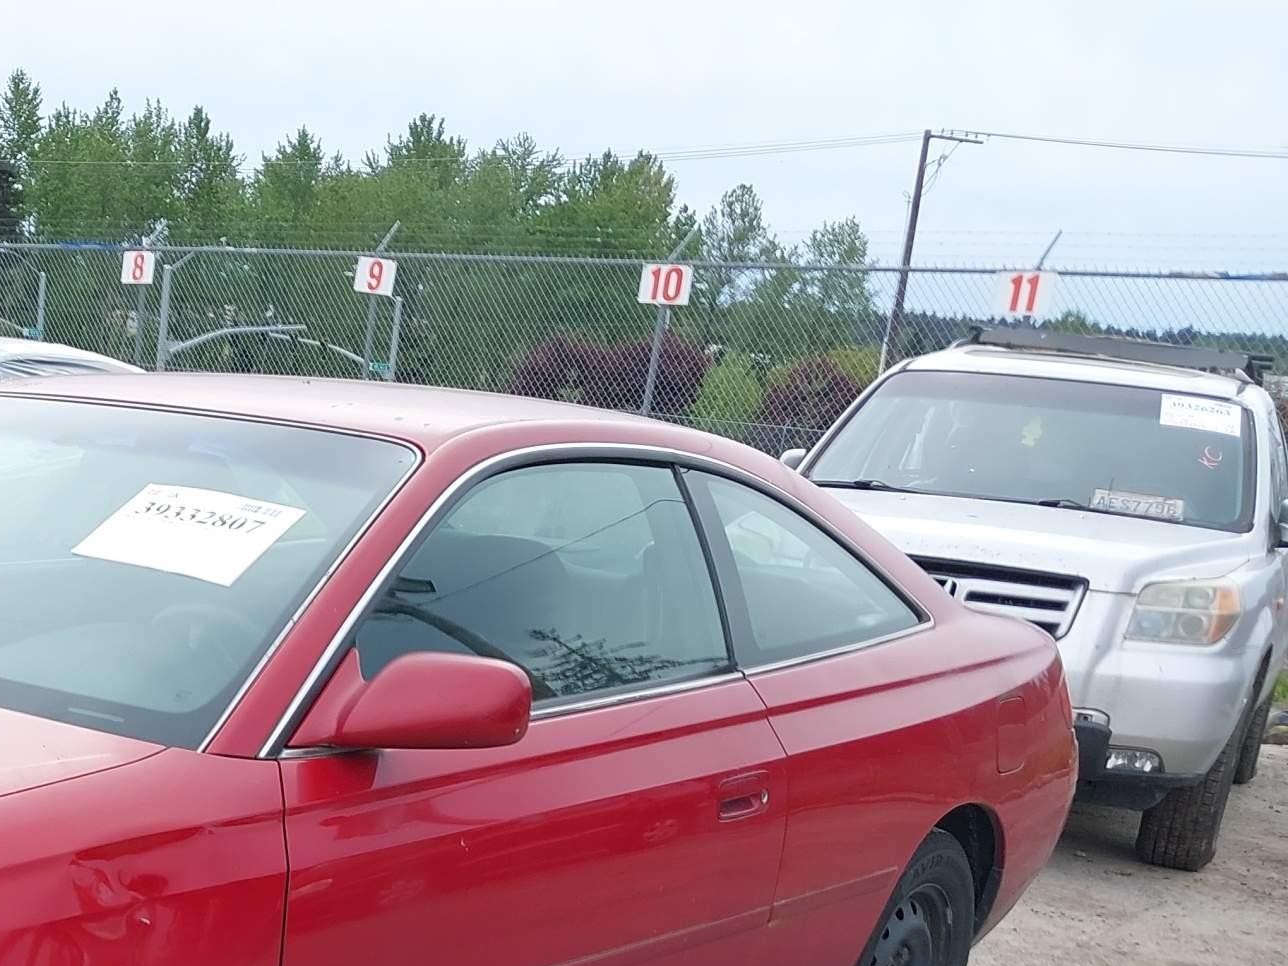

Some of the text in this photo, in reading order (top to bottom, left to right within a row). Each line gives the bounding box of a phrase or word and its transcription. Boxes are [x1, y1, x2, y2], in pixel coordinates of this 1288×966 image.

[131, 253, 145, 281] 8
[367, 260, 384, 291] 9
[650, 266, 685, 302] 10
[1008, 274, 1042, 313] 11
[135, 501, 268, 534] 39332807
